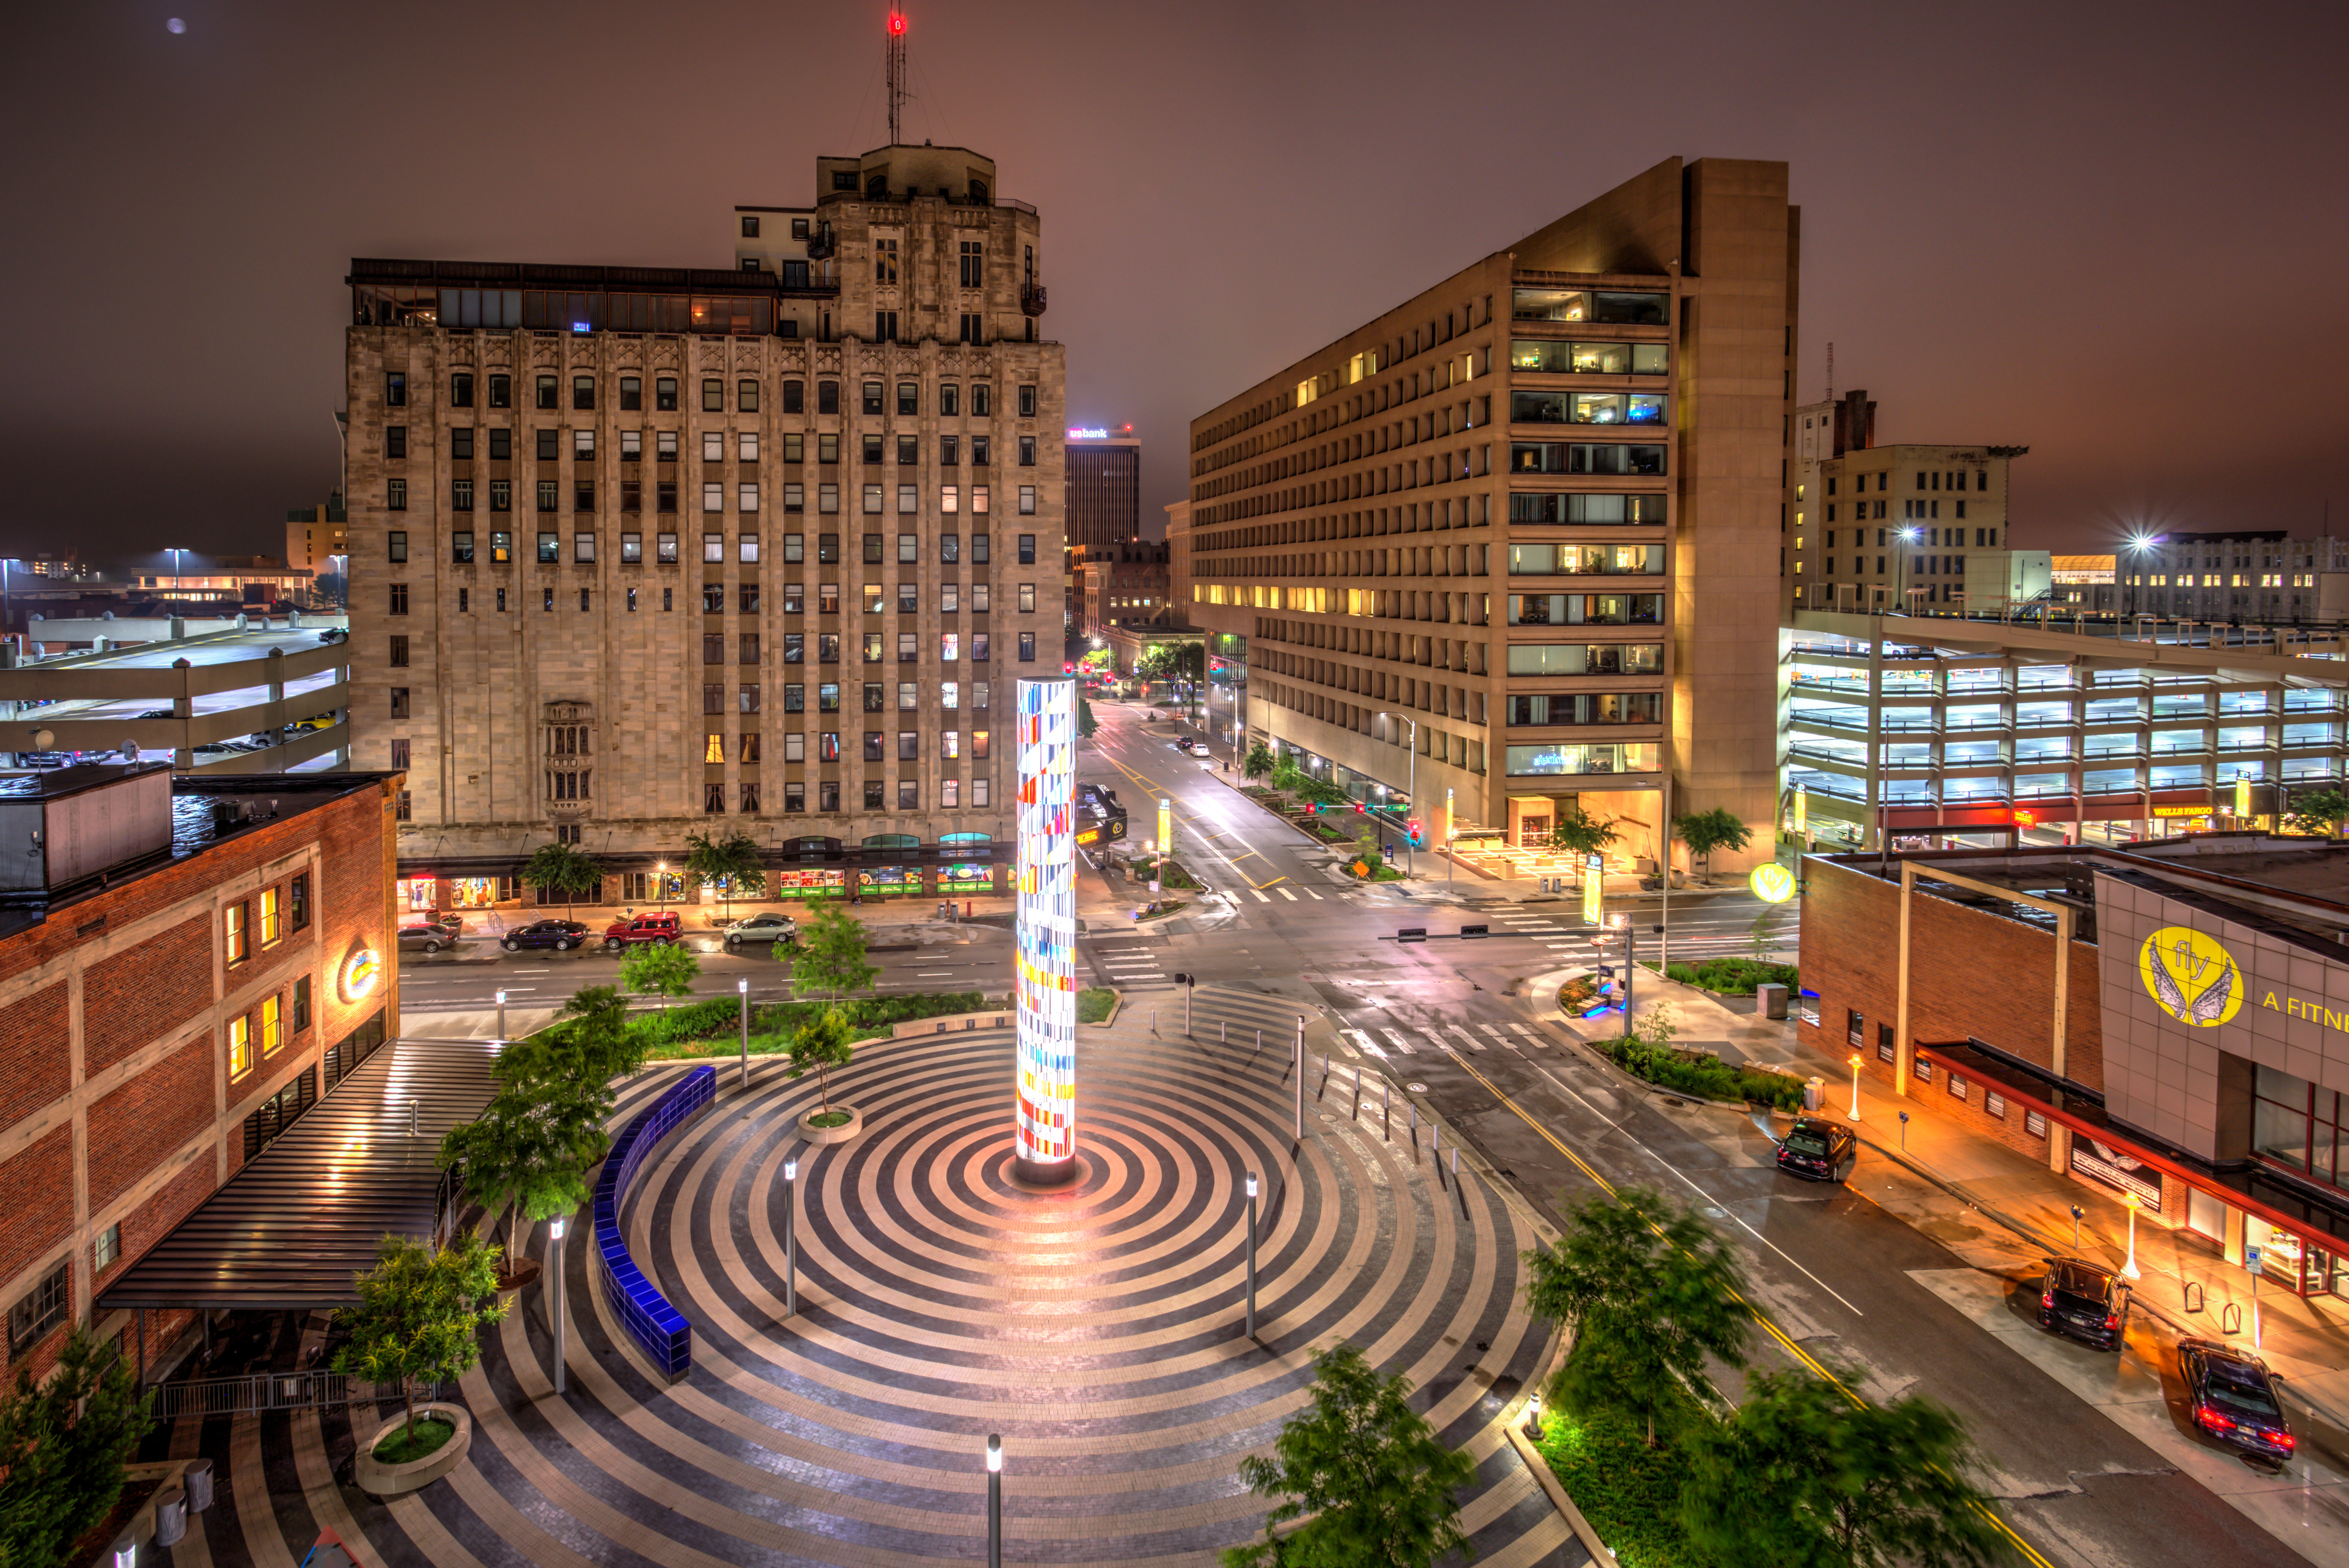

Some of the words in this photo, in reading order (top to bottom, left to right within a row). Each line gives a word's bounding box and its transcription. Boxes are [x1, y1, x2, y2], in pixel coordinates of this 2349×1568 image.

[1764, 868, 1783, 886] fly
[2173, 940, 2210, 980] fly
[2263, 991, 2280, 1011] A
[2091, 1161, 2106, 1169] truth
